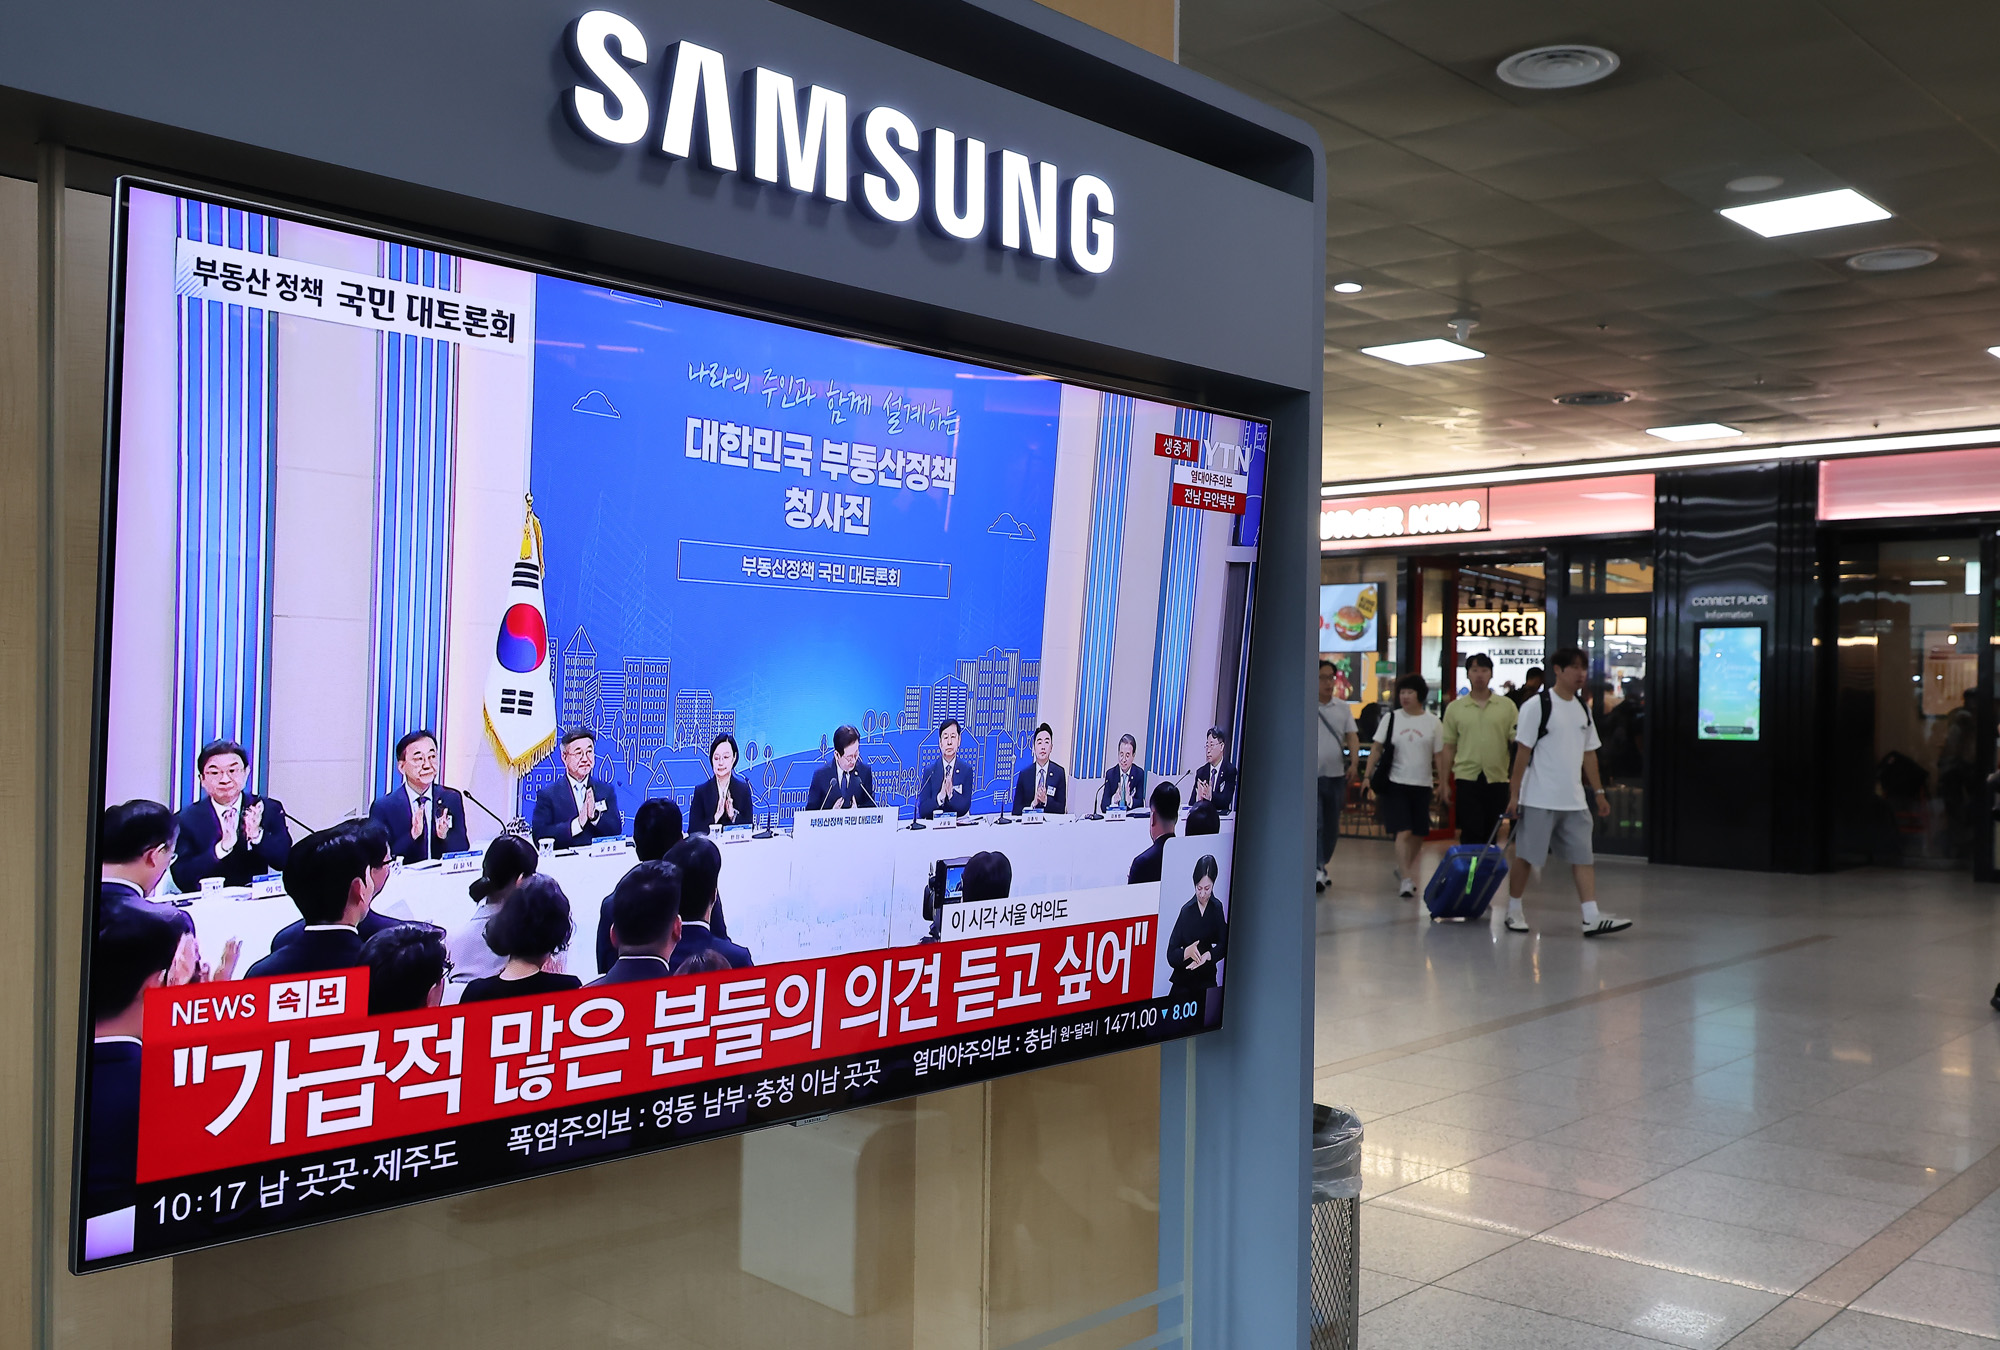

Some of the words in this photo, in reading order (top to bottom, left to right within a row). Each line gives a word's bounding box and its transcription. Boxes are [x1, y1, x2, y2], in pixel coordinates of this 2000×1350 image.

[573, 9, 1115, 274] SAMSUNG
[193, 256, 270, 297] 부동산
[276, 272, 323, 307] 정책
[336, 281, 395, 321] 국민
[406, 292, 515, 343] 대토론회
[688, 361, 750, 394] 나라의
[761, 367, 817, 408] 주인과
[826, 379, 872, 425] 함께
[883, 390, 961, 436] 설계하는
[685, 416, 813, 477] 대한민국
[820, 438, 957, 495] 부동산정책
[1163, 438, 1192, 458] 생중계
[1203, 439, 1251, 472] YTN
[1191, 470, 1233, 488] 열대야주의보
[784, 485, 872, 536] 청사진
[1184, 488, 1201, 505] 전남
[1203, 491, 1235, 510] 무안북부
[1320, 506, 1405, 540] URGER
[1408, 500, 1481, 535] KING
[741, 555, 815, 581] 부동산정책
[818, 561, 845, 584] 국민
[848, 565, 901, 587] 대토론회
[1692, 596, 1735, 606] CONNECT
[1737, 595, 1768, 605] PLACE
[1705, 610, 1753, 620] Information
[1457, 618, 1538, 636] BURGER
[1518, 648, 1545, 656] GRILL
[951, 909, 965, 932] 이
[969, 907, 998, 930] 시각
[999, 902, 1027, 926] 서울
[1030, 899, 1068, 921] 여의도
[171, 993, 256, 1027] NEWS
[276, 982, 340, 1013] 속보
[1104, 1007, 1158, 1035] 1471.00
[1172, 1001, 1198, 1020] 8.00
[173, 1017, 466, 1145] "가급적
[488, 998, 630, 1104] 많은
[646, 967, 827, 1077] 분들의
[839, 955, 940, 1038] 의견
[953, 942, 1042, 1023] 듣고
[1053, 920, 1149, 1006] 싶어"
[296, 1140, 458, 1200] 곳곳·제주도
[506, 1107, 632, 1156] 폭염주의보
[652, 1093, 696, 1128] 영동
[702, 1073, 795, 1119] 남부·충청
[801, 1065, 839, 1097] 이남
[844, 1058, 882, 1092] 곳곳
[913, 1034, 1011, 1076] 열대야주의보
[1024, 1024, 1055, 1053] 충남
[153, 1180, 247, 1225] 10:17
